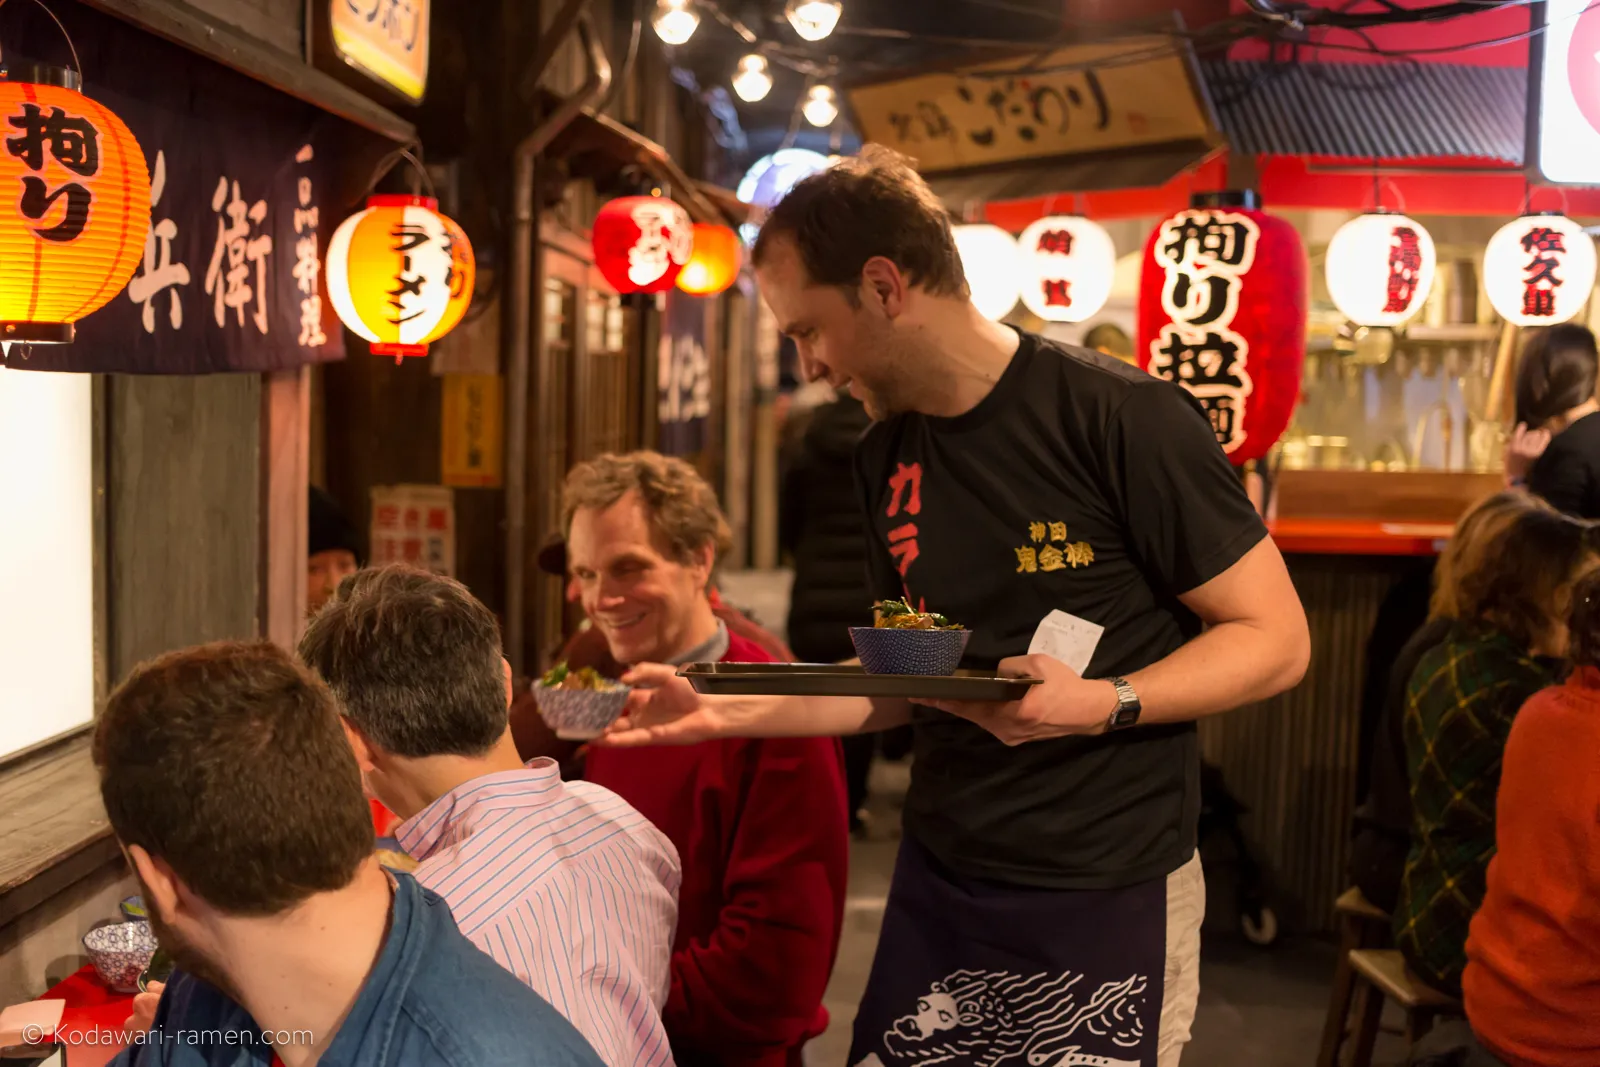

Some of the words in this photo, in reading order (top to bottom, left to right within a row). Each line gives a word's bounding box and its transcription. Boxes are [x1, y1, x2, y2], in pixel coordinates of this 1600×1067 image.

[7, 103, 98, 242] 拘り
[386, 224, 430, 325] ラーメン
[886, 461, 926, 613] カラ
[1014, 541, 1095, 574] 鬼金棒
[1028, 521, 1067, 543] 神田
